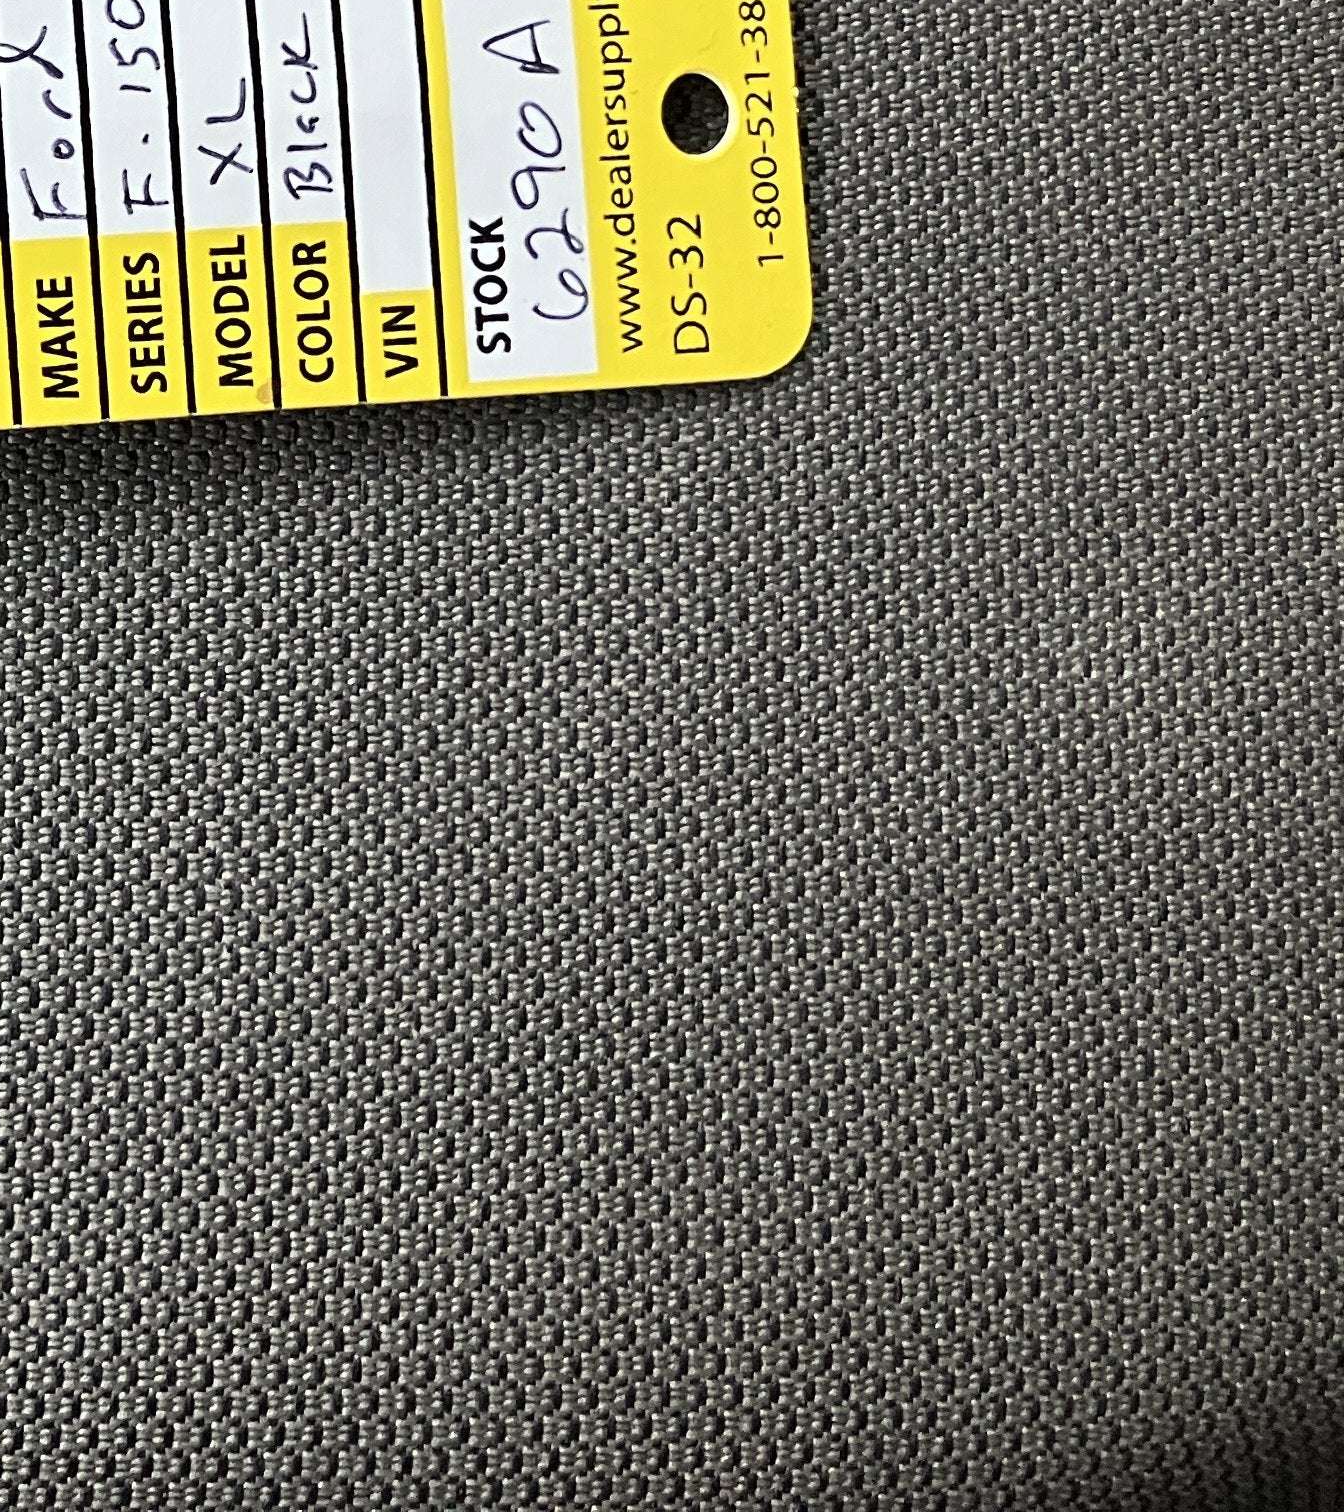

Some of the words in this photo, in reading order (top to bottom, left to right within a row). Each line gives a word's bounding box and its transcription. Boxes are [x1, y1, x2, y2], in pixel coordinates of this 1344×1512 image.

[282, 12, 333, 201] Black
[482, 18, 559, 75] A
[198, 77, 254, 185] XL
[510, 101, 589, 321] 6290
[36, 275, 80, 398] MAKE
[123, 252, 167, 394] SERIES
[210, 234, 254, 387] MODEL
[293, 239, 334, 383] COLOR
[381, 304, 418, 378] VIN
[469, 216, 511, 354] STOCK
[668, 213, 710, 356] DS-32
